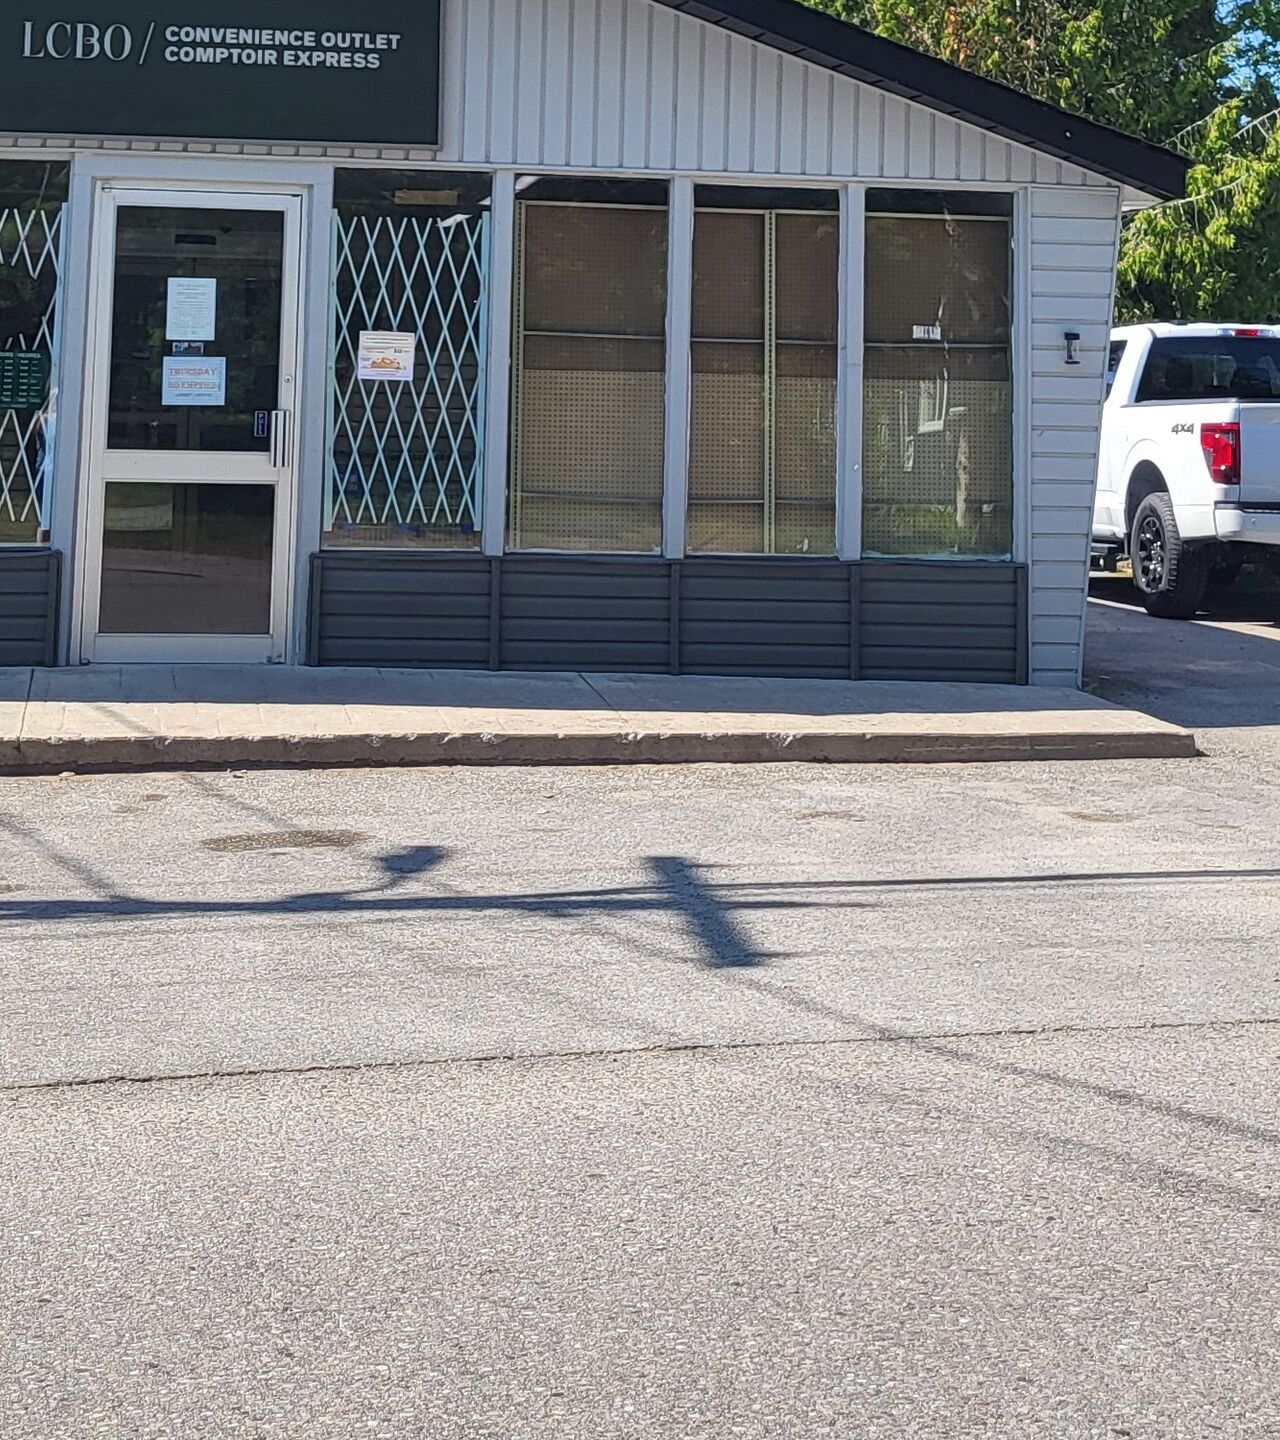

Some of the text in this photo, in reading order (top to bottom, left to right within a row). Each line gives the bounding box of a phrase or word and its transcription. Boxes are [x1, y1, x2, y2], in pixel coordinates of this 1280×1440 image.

[22, 21, 132, 61] LCBO
[165, 26, 401, 50] CONVENIENCE OUTLET
[164, 46, 381, 70] COMPTOIR EXPRESS
